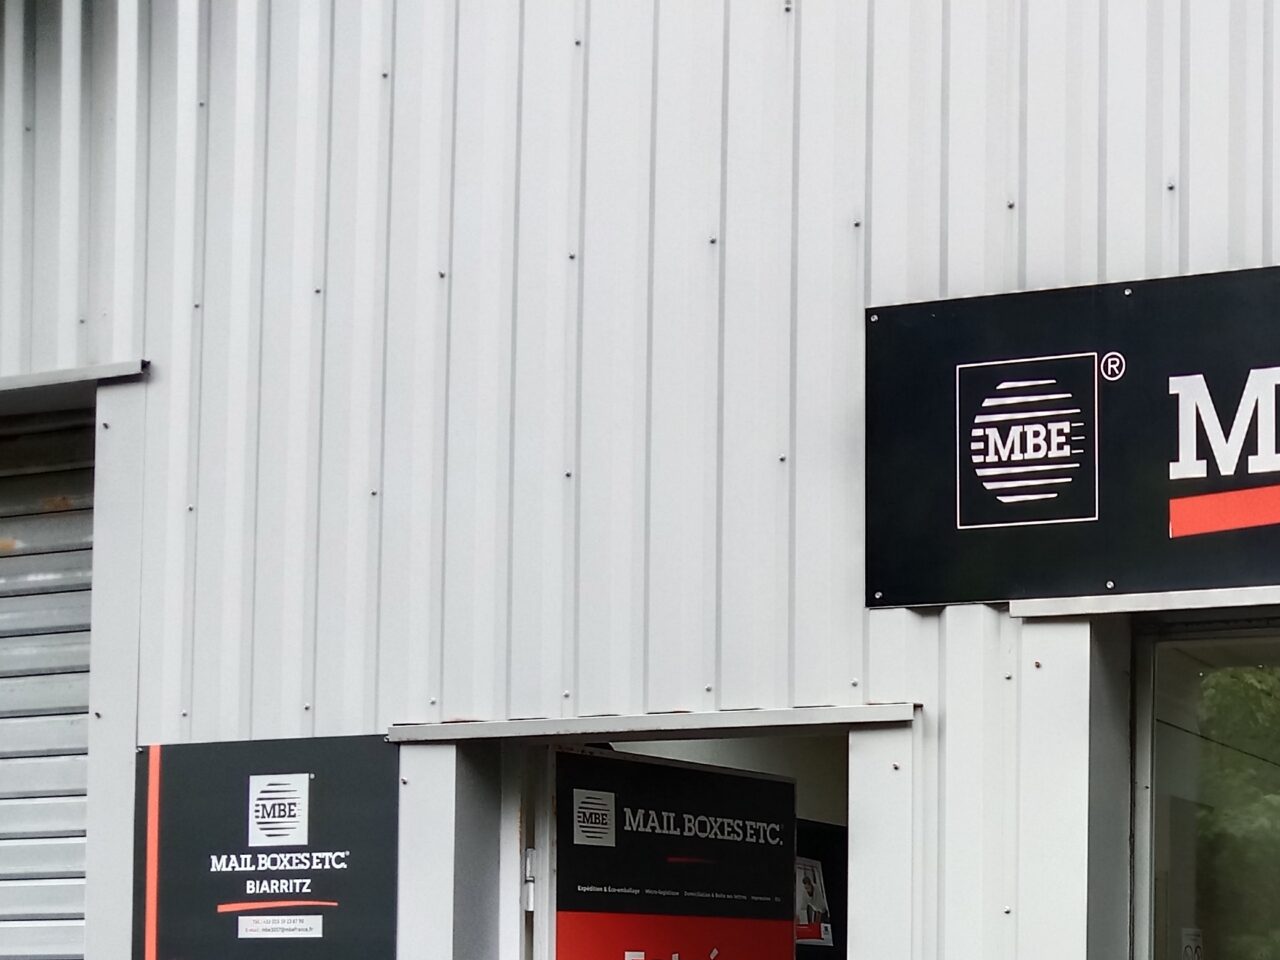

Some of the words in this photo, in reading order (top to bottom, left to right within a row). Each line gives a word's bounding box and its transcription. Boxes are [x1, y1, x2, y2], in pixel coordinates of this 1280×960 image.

[985, 422, 1071, 463] MBE
[261, 803, 296, 818] MBE
[582, 812, 607, 826] MBE
[624, 808, 680, 835] MAIL
[683, 814, 743, 841] BOXES
[746, 821, 783, 846] ETC.
[210, 855, 256, 871] MAIL
[257, 853, 310, 871] BOXES
[312, 851, 347, 869] ETC.
[246, 879, 311, 894] BIARRITZ
